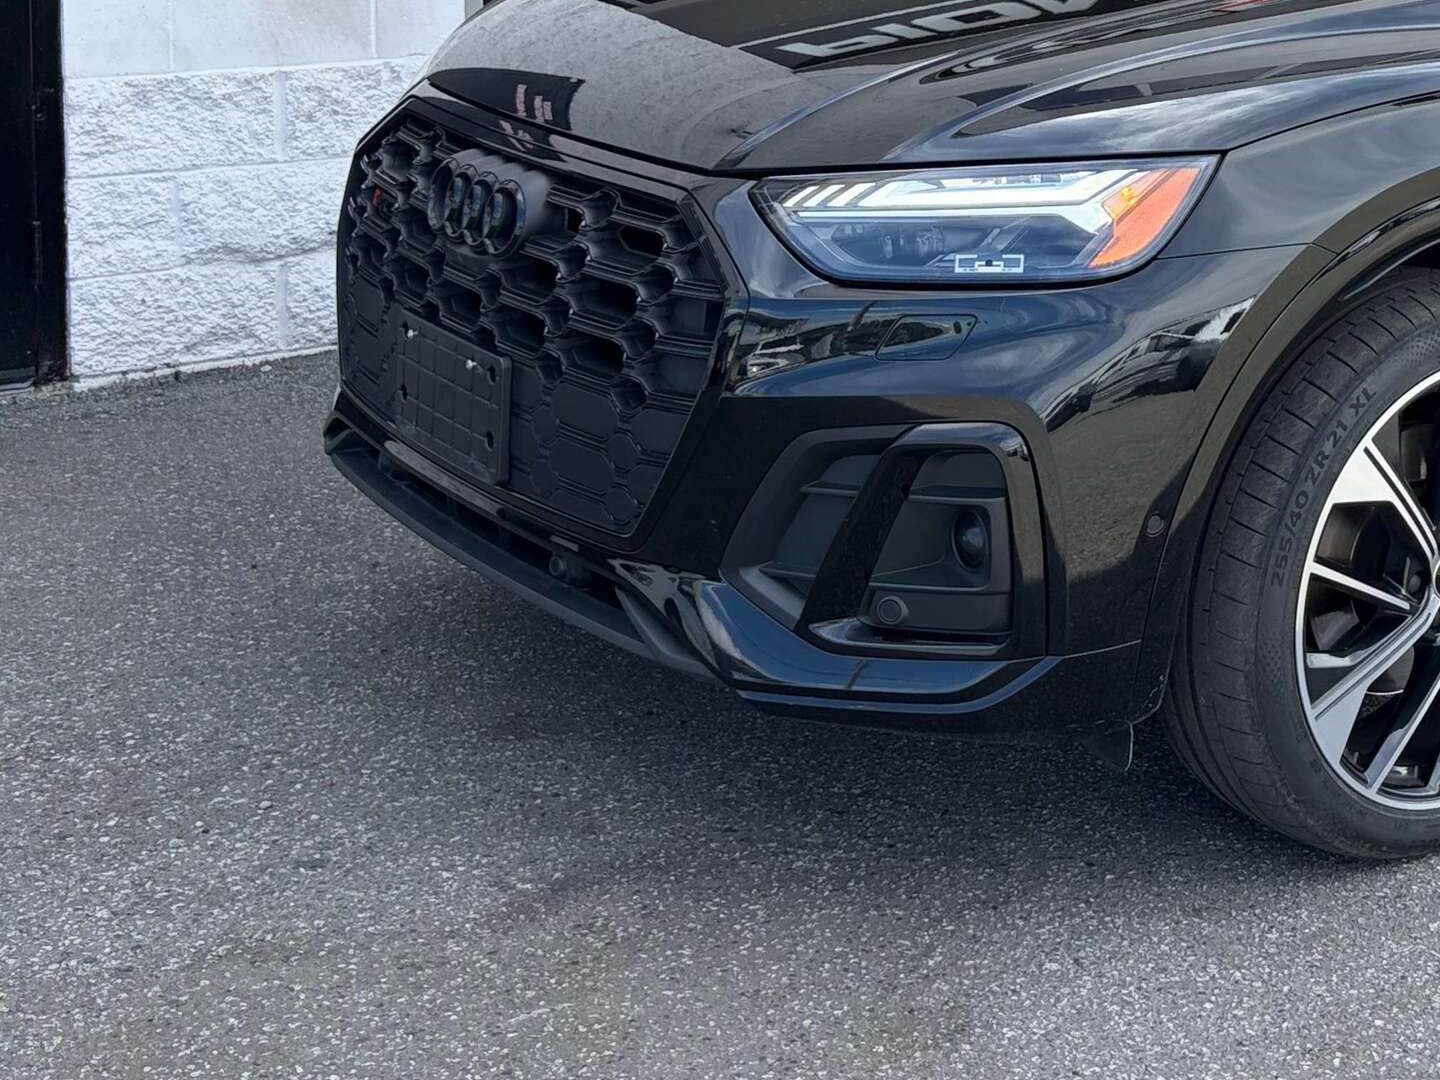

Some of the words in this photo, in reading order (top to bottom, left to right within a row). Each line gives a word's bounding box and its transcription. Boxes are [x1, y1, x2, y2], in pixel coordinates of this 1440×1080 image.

[1271, 490, 1309, 589] 255/40
[1304, 451, 1331, 488] ZR
[1328, 422, 1348, 449] 21
[1349, 386, 1378, 416] XL
